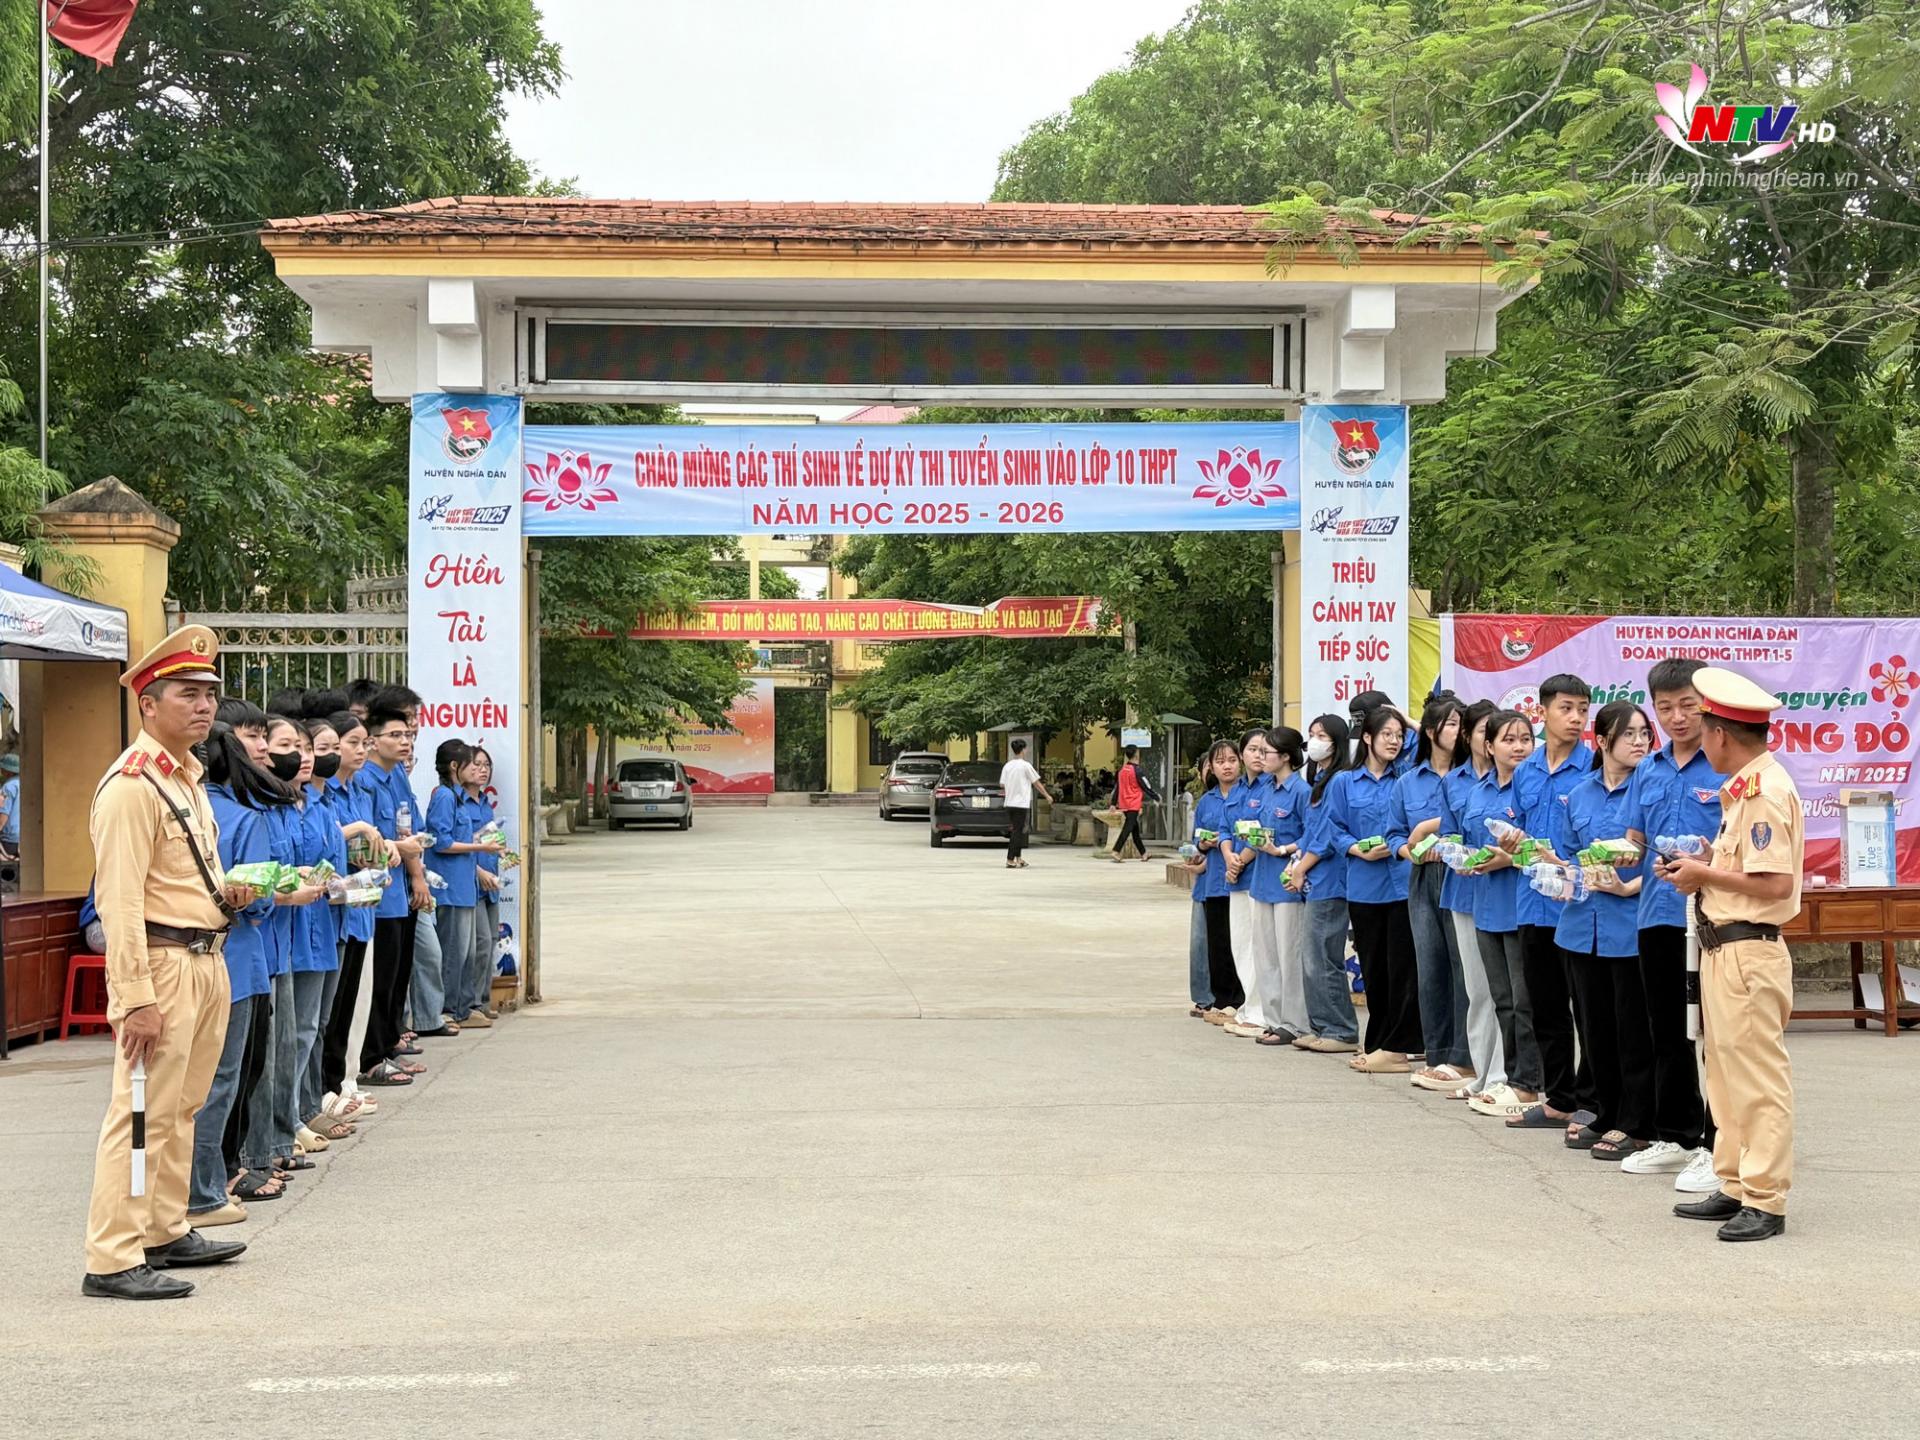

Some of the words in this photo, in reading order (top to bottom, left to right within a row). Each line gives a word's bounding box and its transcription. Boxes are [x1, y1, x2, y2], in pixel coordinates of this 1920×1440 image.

[425, 469, 454, 478] HUYỆN
[635, 443, 678, 488] CHÀO
[683, 444, 731, 488] MỪNG
[736, 443, 768, 487] CÁC
[772, 443, 797, 487] THÍ
[802, 450, 840, 487] SINH
[845, 438, 864, 487] VỀ
[869, 447, 892, 495] DỰ
[895, 442, 915, 487] KỲ
[919, 449, 944, 486] THI
[948, 434, 998, 486] TUYỂN
[1003, 448, 1041, 486] SINH
[1045, 441, 1077, 486] VÀO
[1081, 441, 1110, 486] LỚP
[1116, 449, 1134, 485] 10
[1139, 448, 1178, 485] THPT
[1315, 480, 1344, 490] HUYỆN
[473, 507, 508, 522] 2025
[753, 498, 818, 525] NĂM
[830, 503, 893, 529] HỌC
[904, 502, 970, 524] 2025
[998, 502, 1064, 523] 2026
[1363, 517, 1396, 533] 2025
[425, 553, 505, 588] Hiền
[1332, 556, 1375, 589] TRIỆU
[744, 608, 765, 631] MỚI
[768, 609, 796, 631] SÁNG
[800, 613, 823, 635] TẠO,
[825, 609, 855, 631] NÂNG
[858, 613, 880, 631] CAO
[882, 606, 911, 629] CHẤT
[913, 611, 947, 634] LƯỢNG
[1002, 607, 1016, 628] VÀ
[1018, 607, 1039, 628] ĐÀO
[1313, 596, 1362, 622] CÁNH
[1368, 601, 1396, 622] TAY
[438, 611, 487, 642] Tài
[1615, 625, 1664, 641] HUYỆN
[1667, 625, 1711, 639] ĐOÀN
[1715, 625, 1763, 640] NGHĨA
[1319, 632, 1351, 661] TIẾP
[1356, 634, 1389, 661] SỨC
[1622, 645, 1666, 660] ĐOÀN
[1671, 645, 1730, 660] TRƯỜNG
[1735, 647, 1769, 660] THPT
[1772, 648, 1792, 661] 1-5
[452, 656, 477, 686] LÀ
[1334, 675, 1349, 700] SĨ
[1774, 687, 1867, 712] nguyện
[419, 697, 508, 728] NGUYÊN
[1855, 711, 1910, 753] ĐỎ
[1819, 764, 1861, 784] NĂM
[1864, 766, 1907, 783] 2025
